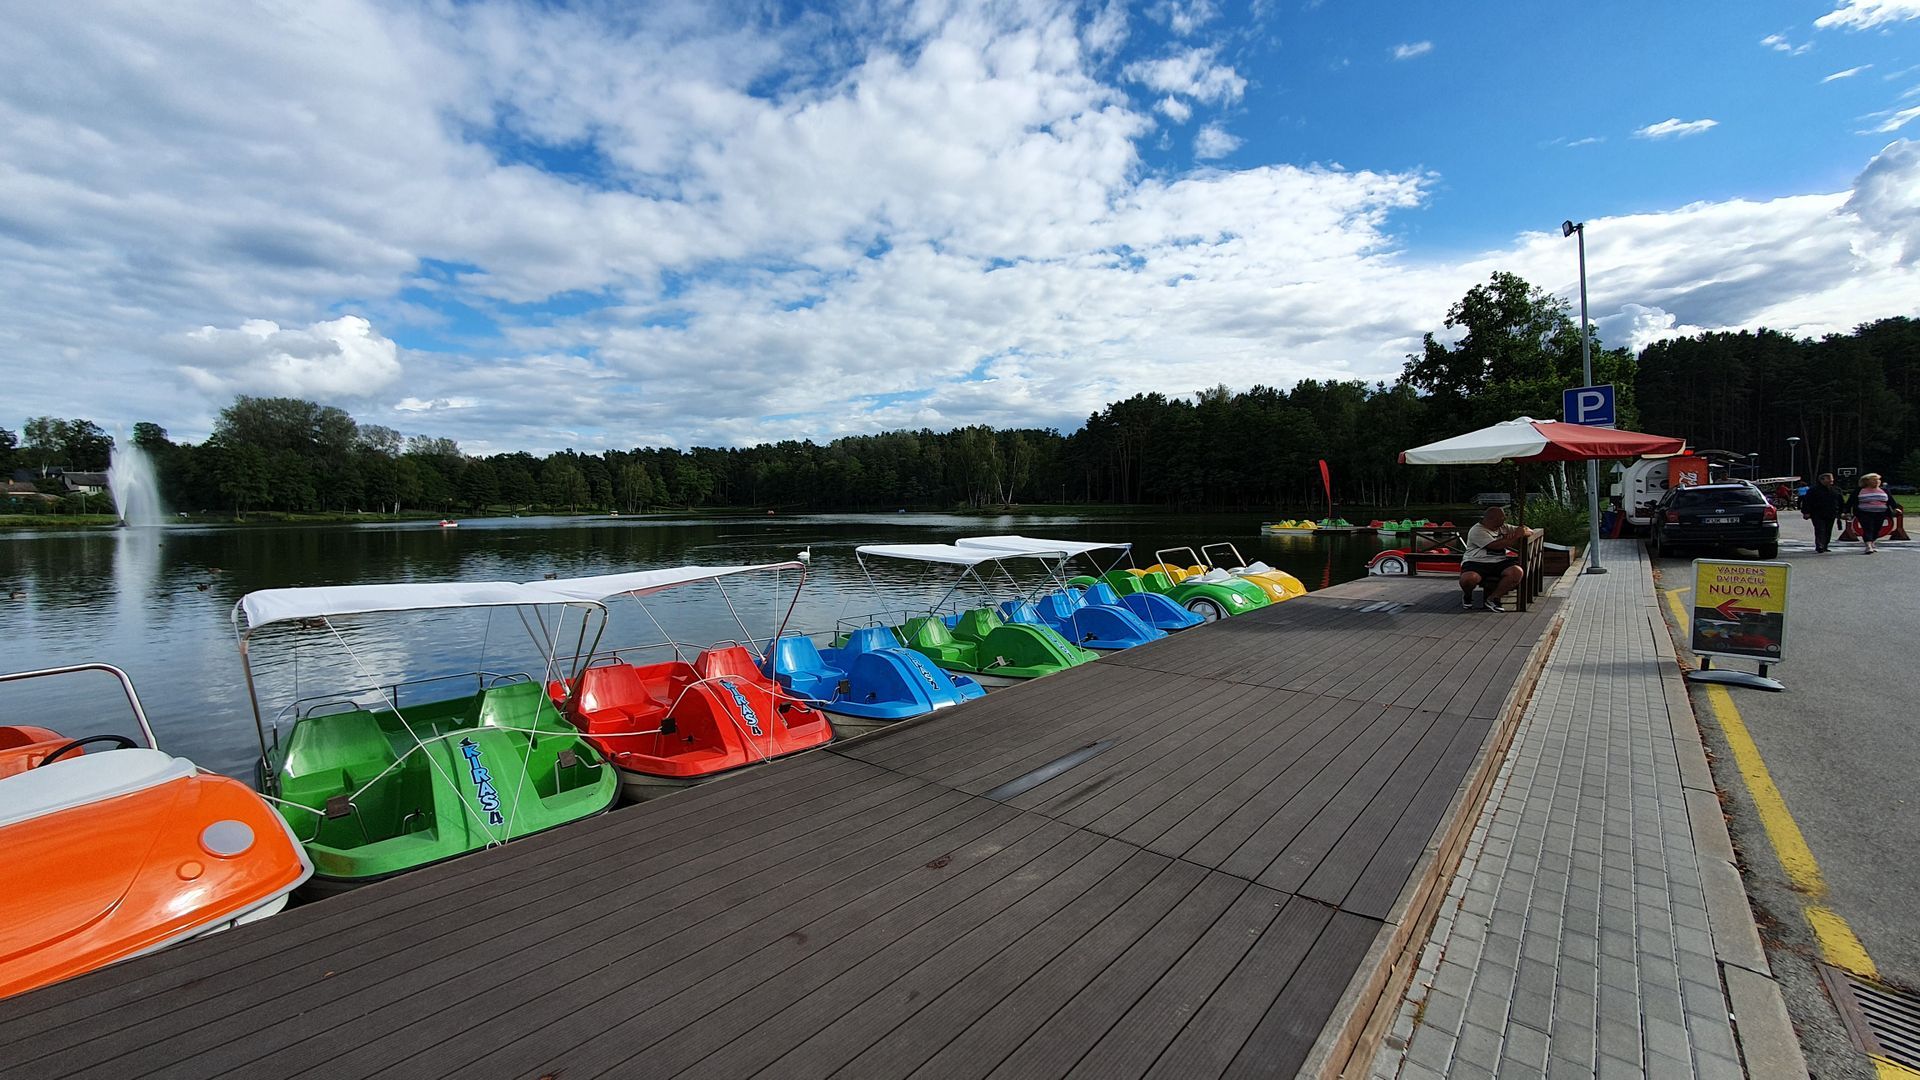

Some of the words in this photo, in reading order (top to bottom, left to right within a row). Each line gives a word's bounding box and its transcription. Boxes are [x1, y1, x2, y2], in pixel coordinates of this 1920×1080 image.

[1577, 391, 1605, 422] P
[1717, 567, 1766, 575] VANDENS
[1709, 584, 1771, 598] NUOMA
